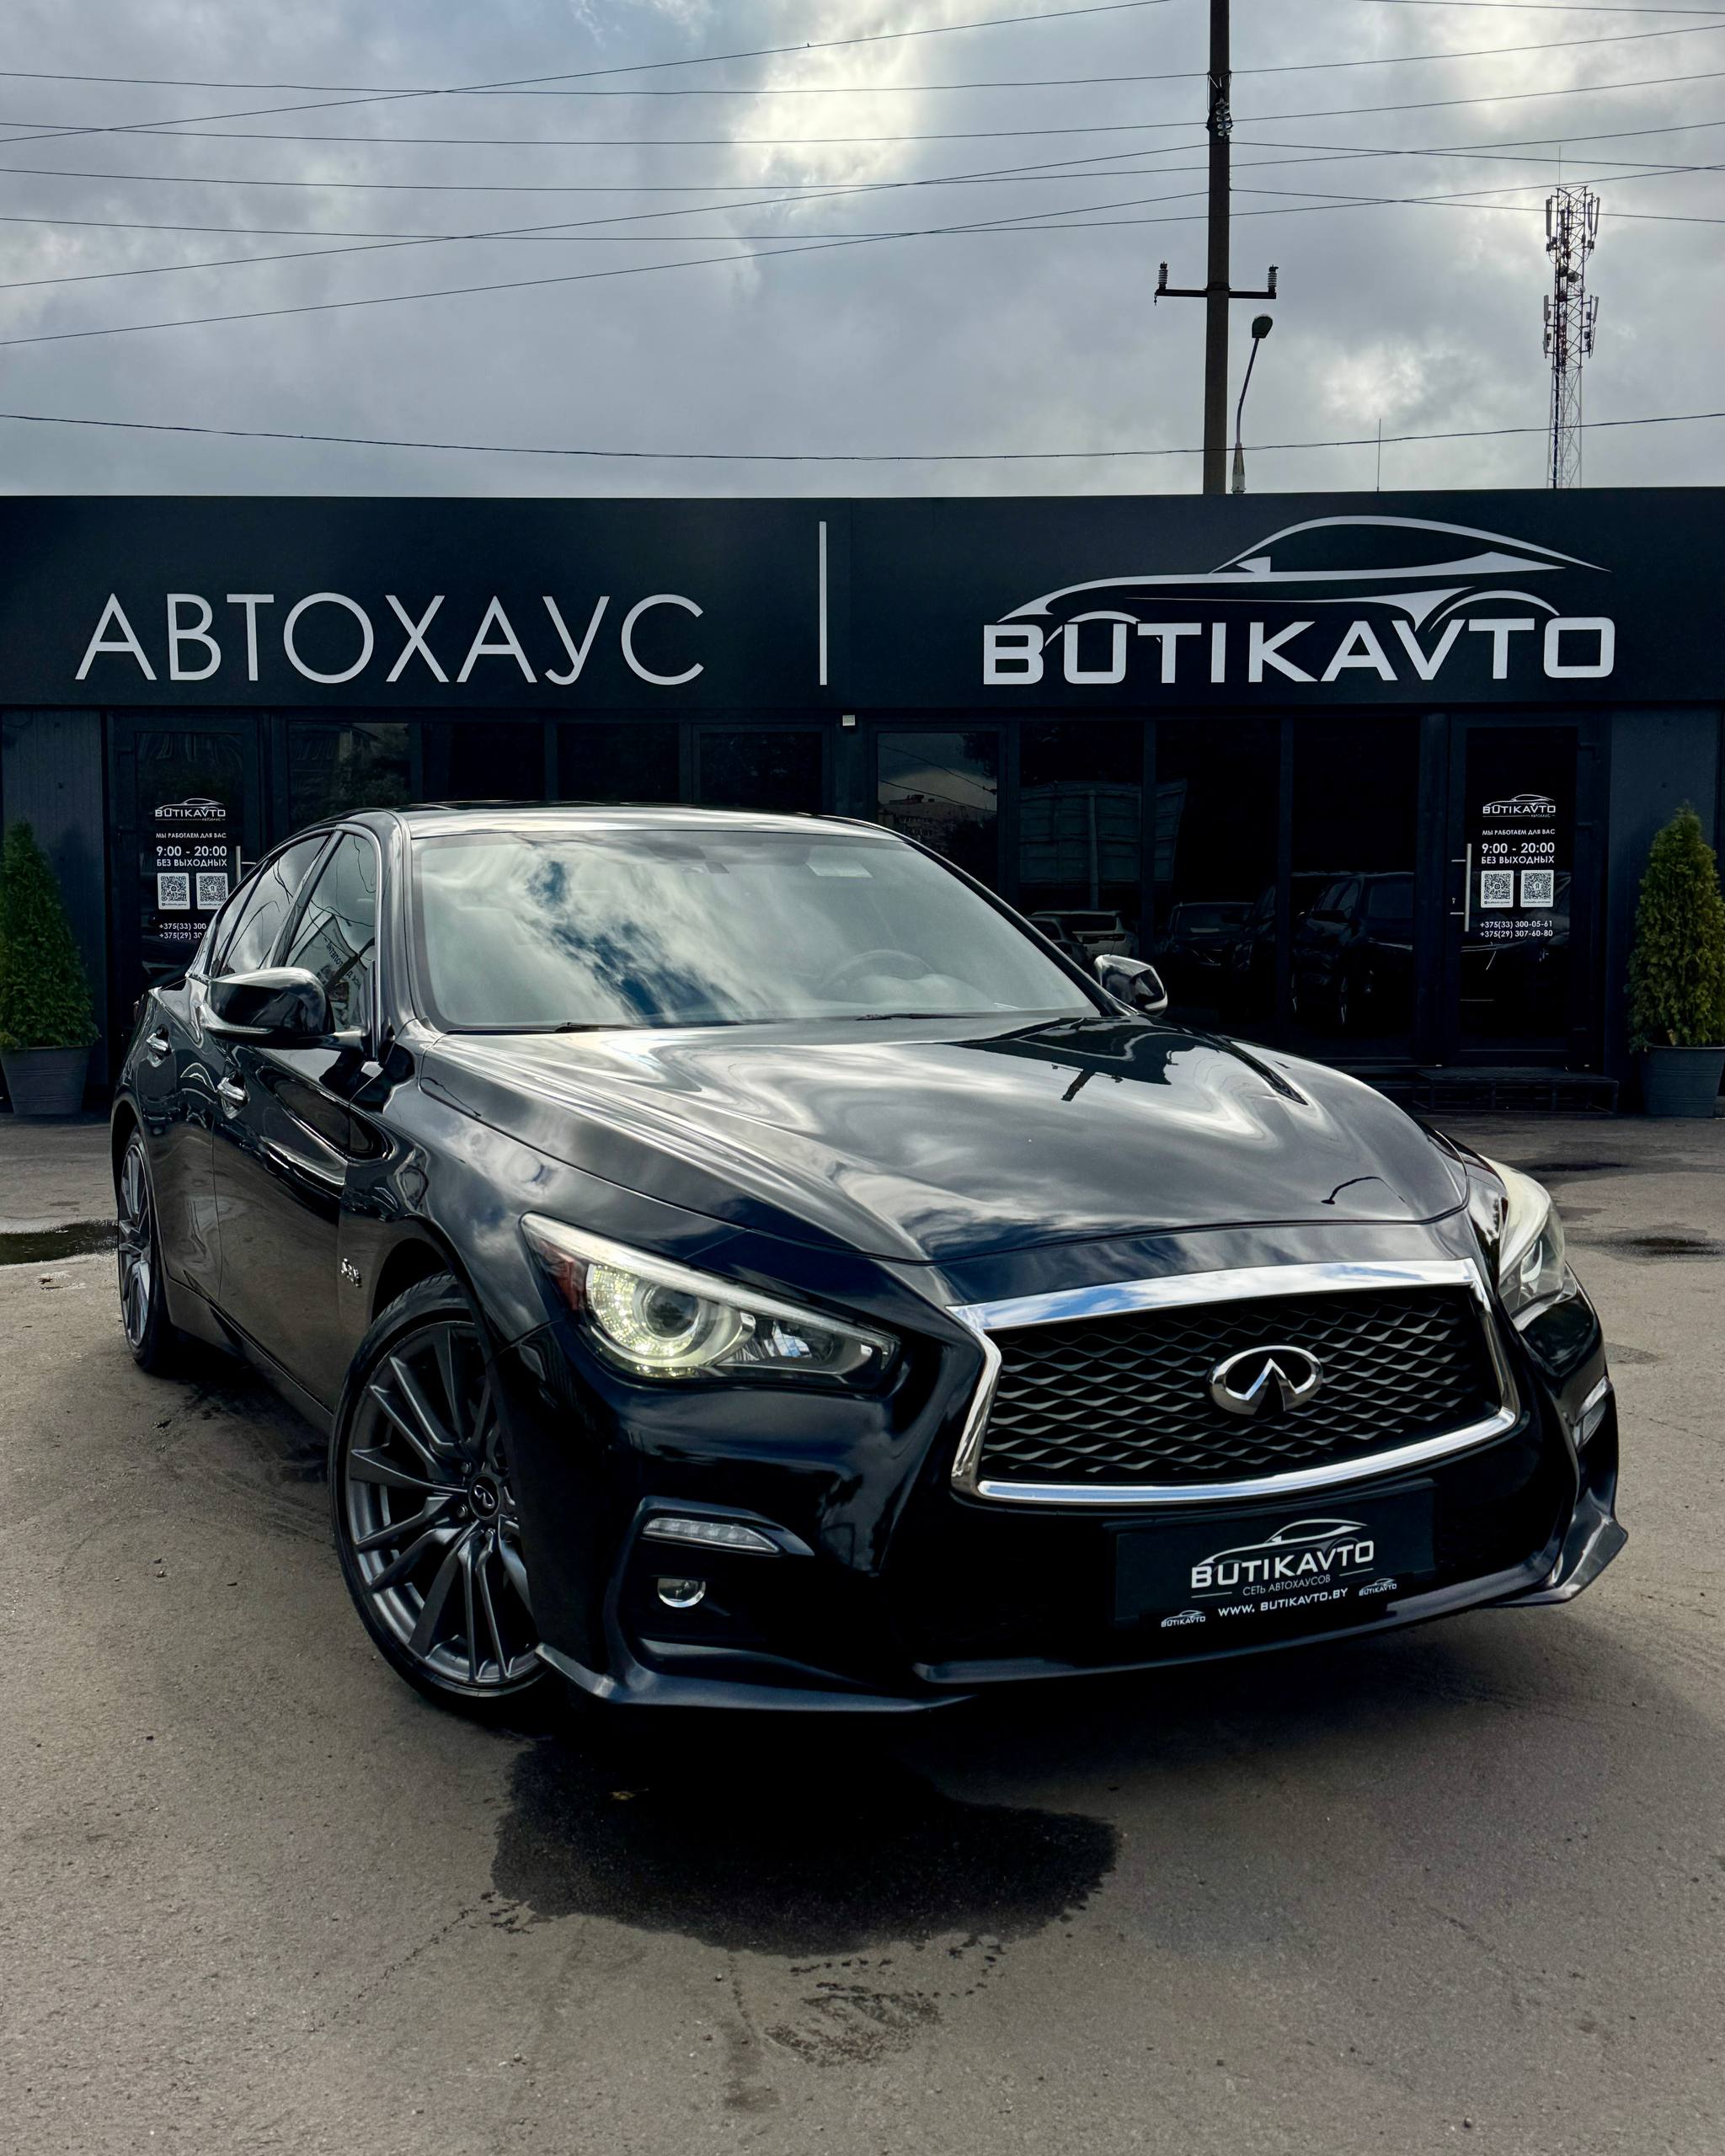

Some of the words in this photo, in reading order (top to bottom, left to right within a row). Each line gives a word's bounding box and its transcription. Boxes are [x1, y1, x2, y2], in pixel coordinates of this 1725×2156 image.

[76, 593, 703, 686] АВТОХАУС
[983, 616, 1616, 685] BUTIKAVTO
[154, 808, 226, 818] BUTIKAVTO
[156, 846, 182, 857] 9:00
[194, 846, 227, 857] 20:00
[1482, 843, 1508, 854] 9:00
[1520, 842, 1555, 853] 20:00
[174, 858, 227, 867] ВЫХОДНЫХ
[1499, 856, 1555, 864] ВЫХОДНЫХ
[1480, 921, 1513, 930] +375(33)
[1191, 1540, 1375, 1588] BUTIKAVTO
[1242, 1585, 1266, 1596] СЕТЬ
[1268, 1574, 1331, 1593] АВТОХАУСОВ
[1359, 1582, 1397, 1596] BUTIKAVTO
[1218, 1604, 1255, 1617] WWW.
[1260, 1588, 1348, 1611] BUTIKAVTO.BY
[1161, 1615, 1206, 1628] BUTIKAVTO
